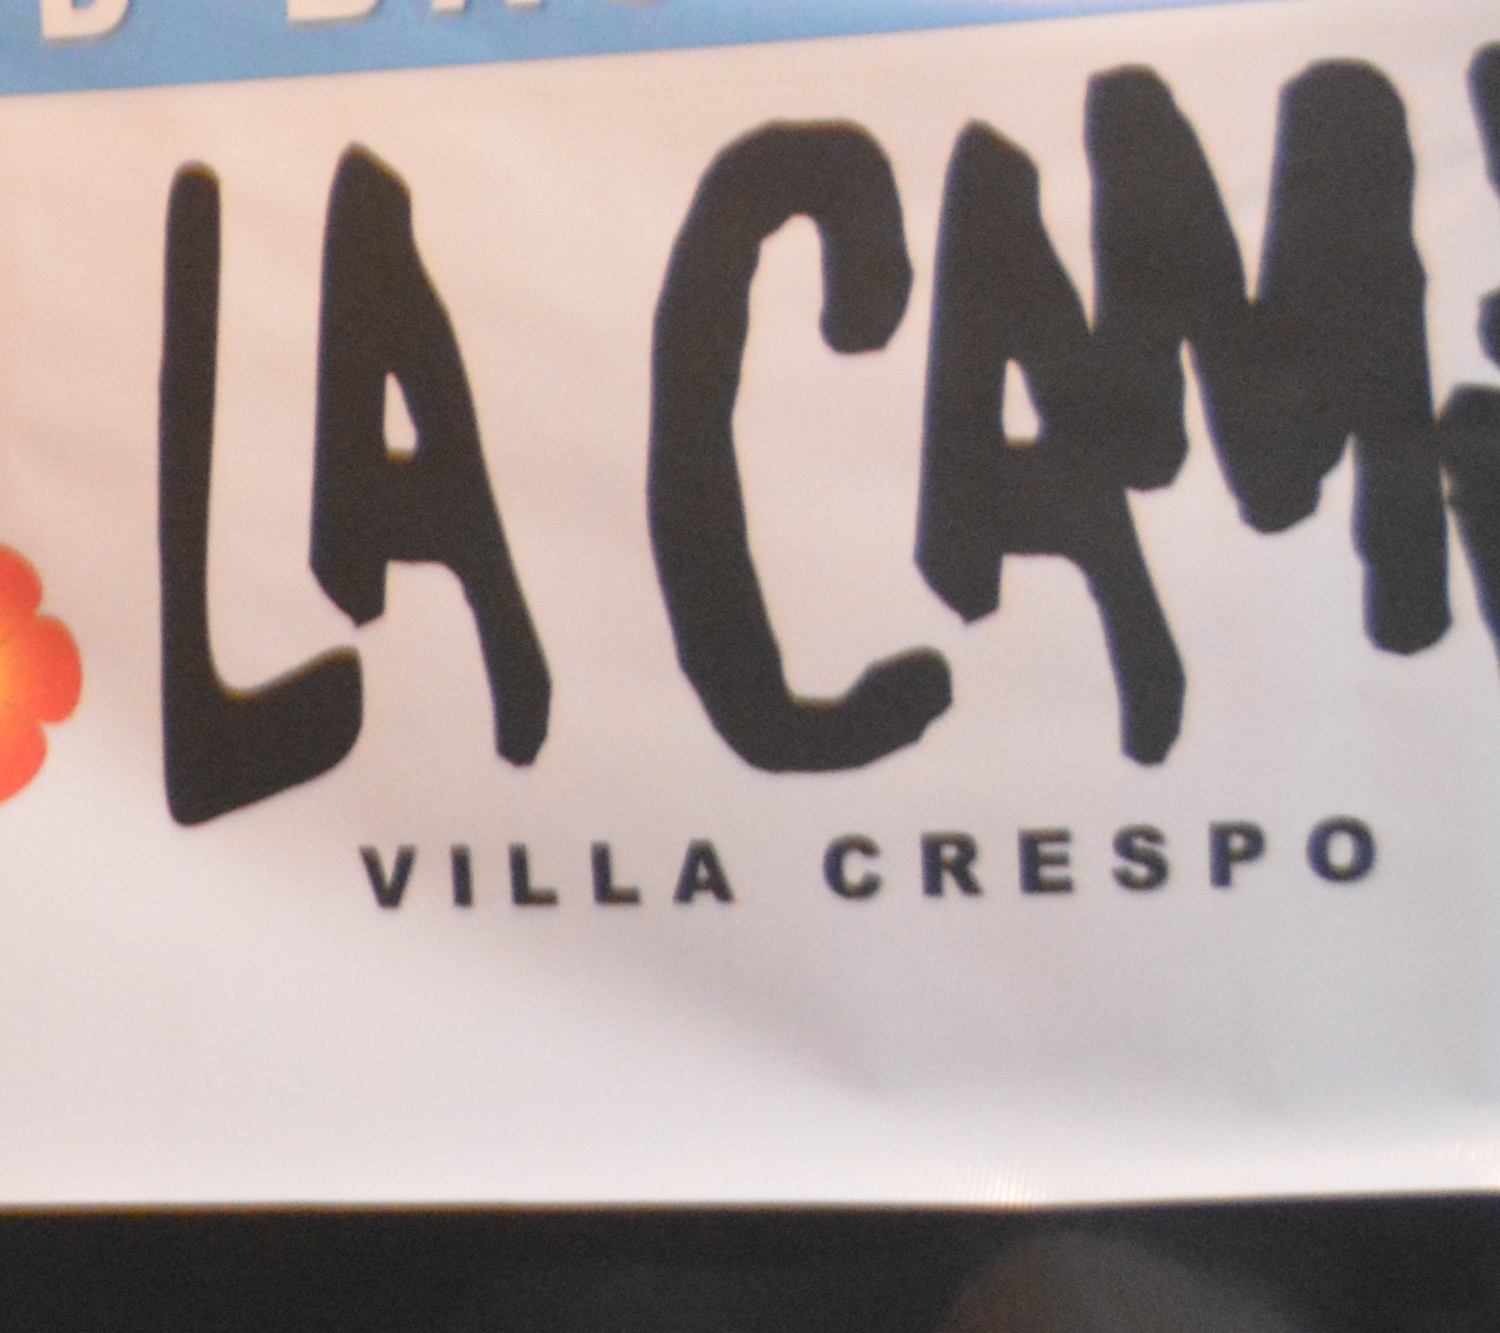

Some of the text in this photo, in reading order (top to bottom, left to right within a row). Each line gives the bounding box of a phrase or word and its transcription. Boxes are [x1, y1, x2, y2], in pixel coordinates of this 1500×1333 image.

[156, 142, 553, 826] LA
[358, 815, 1380, 909] VILLA CRESPO
